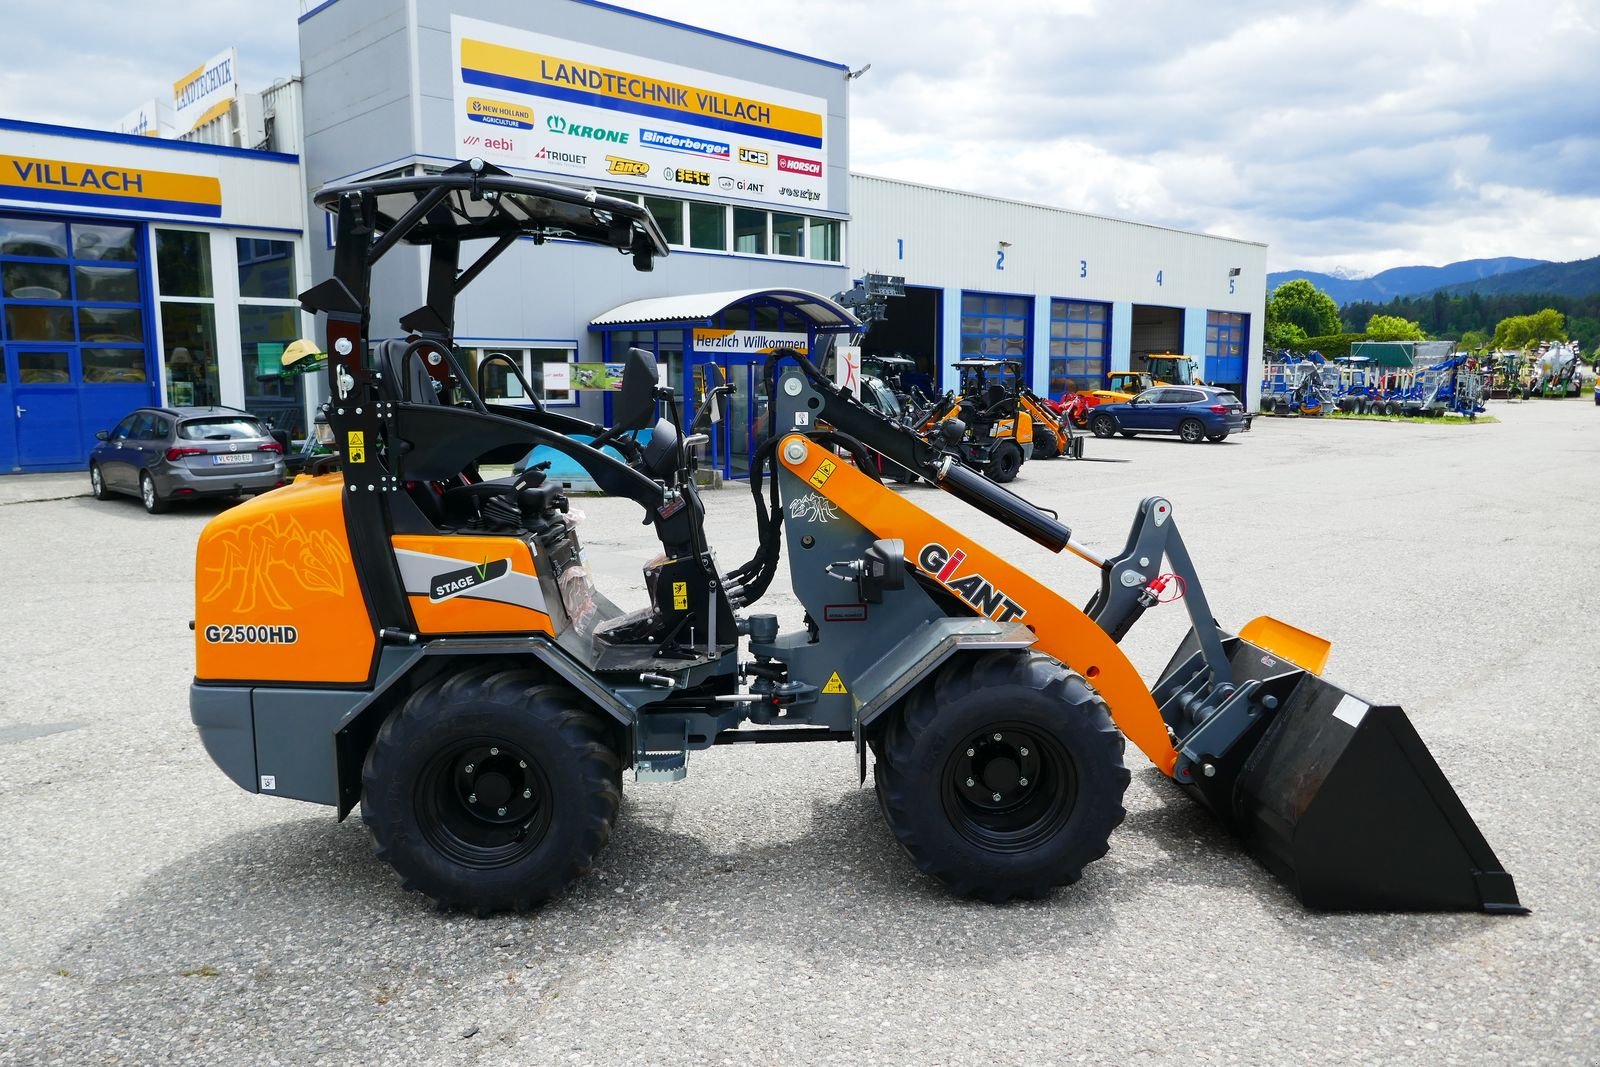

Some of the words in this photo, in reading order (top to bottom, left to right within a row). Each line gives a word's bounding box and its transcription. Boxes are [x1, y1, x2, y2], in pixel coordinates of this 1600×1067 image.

[176, 58, 232, 111] LANDTECHNIK
[541, 60, 689, 108] LANDTECHNIK
[696, 93, 771, 124] VILLACH
[483, 105, 498, 114] NEW
[499, 107, 529, 119] HOLLAND
[483, 116, 519, 128] AGRICULTURE
[568, 124, 630, 144] KRONE
[643, 130, 728, 154] Binderberger
[485, 138, 513, 151] aebi
[605, 155, 649, 175] Tanco
[740, 150, 768, 165] JCB
[787, 160, 819, 173] HORSCH
[13, 160, 143, 193] VILLACH
[897, 239, 903, 260] 1
[996, 251, 1004, 271] 2
[1080, 260, 1087, 278] 3
[1156, 270, 1162, 286] 4
[1229, 280, 1234, 294] 5
[697, 334, 739, 348] Herzlich
[743, 336, 805, 350] Willkommen
[435, 575, 475, 597] STAGE
[205, 625, 298, 645] G2500HD
